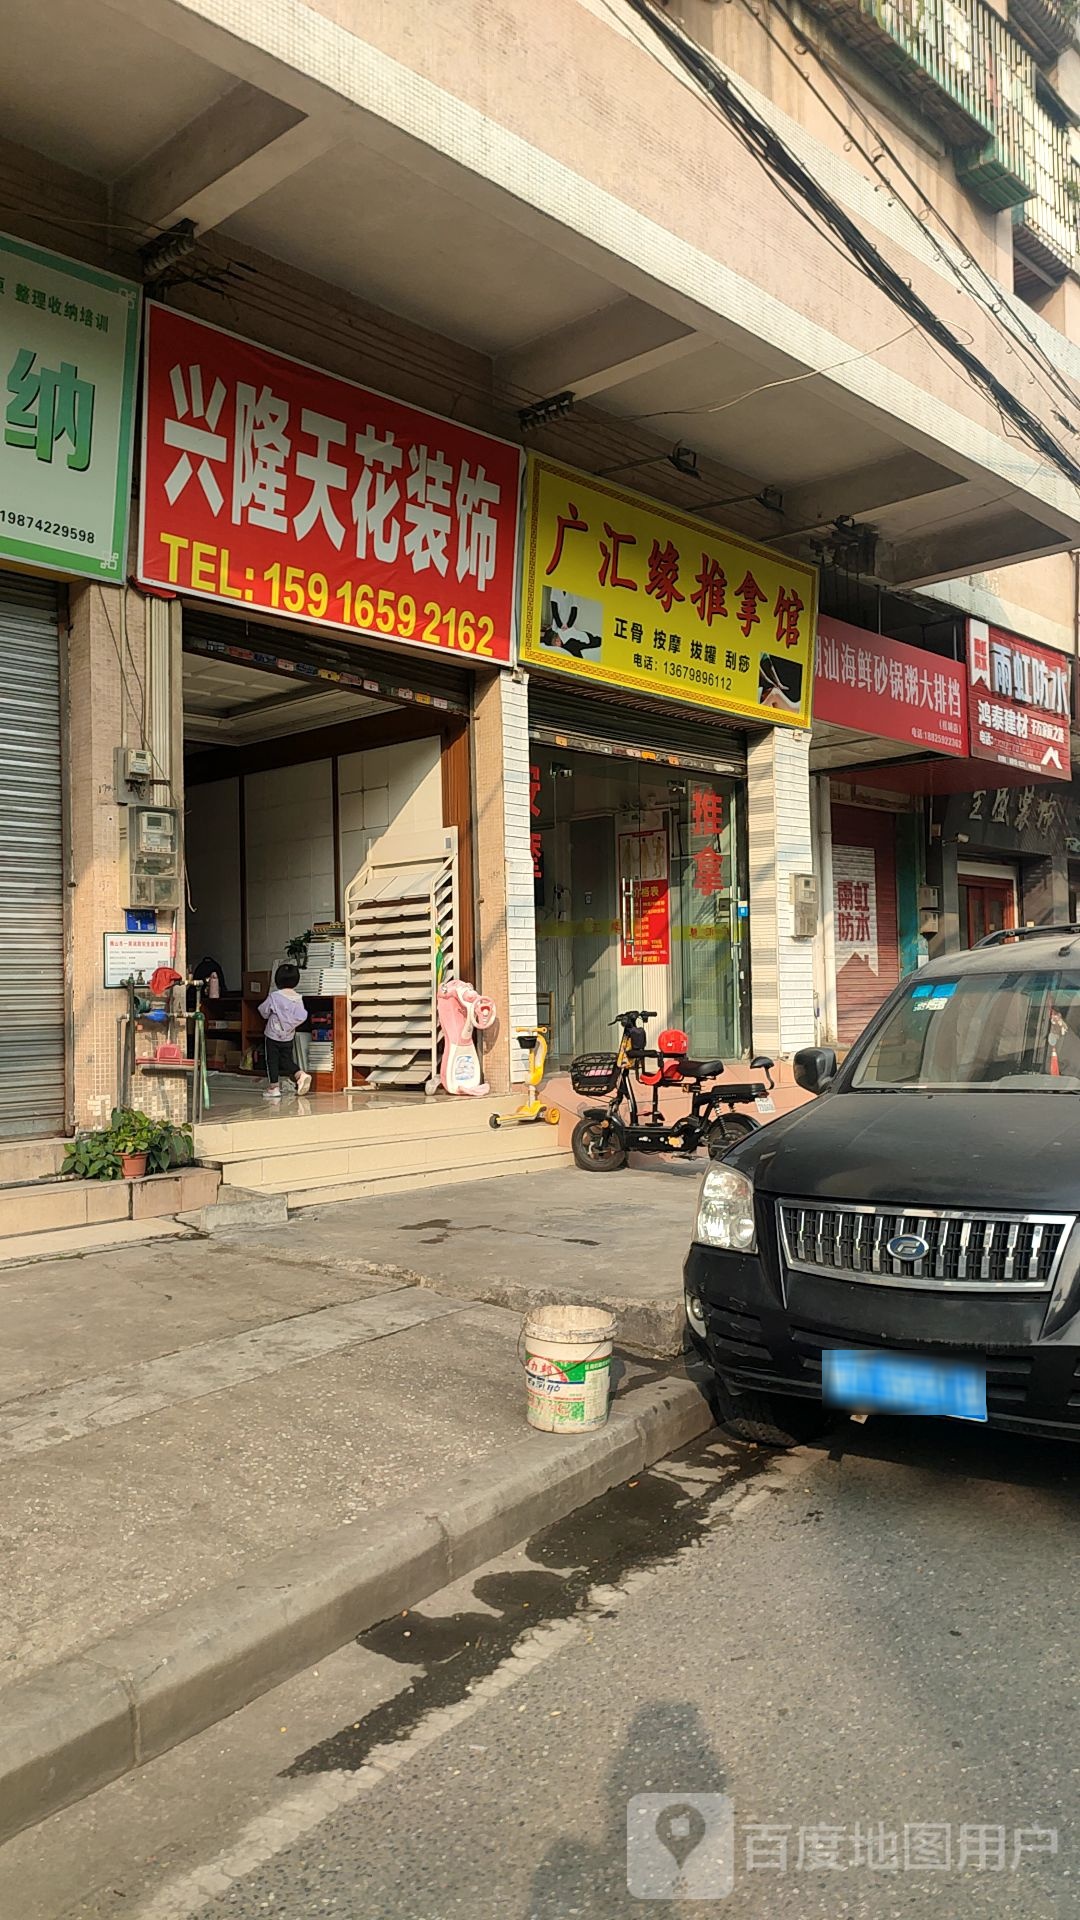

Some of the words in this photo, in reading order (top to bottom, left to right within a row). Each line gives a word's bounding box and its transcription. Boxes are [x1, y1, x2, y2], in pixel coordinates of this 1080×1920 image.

[15, 283, 109, 333] 整理收纳培训
[4, 348, 96, 473] 纳
[163, 363, 501, 592] 兴隆天花装饰
[0, 510, 95, 544] 19874229598
[263, 562, 329, 618] 159
[335, 580, 416, 637] 1659
[422, 602, 495, 656] 2162
[545, 502, 805, 649] 广汇缘推拿馆
[613, 616, 644, 644] 正骨
[653, 628, 682, 654] 按摩
[690, 639, 717, 665] 拔罐
[725, 650, 751, 675] 刮痧
[991, 642, 1070, 715] 雨虹防水
[977, 699, 1029, 739] 鸿泰建材
[692, 787, 725, 897] 推拿
[837, 912, 871, 942] 防水
